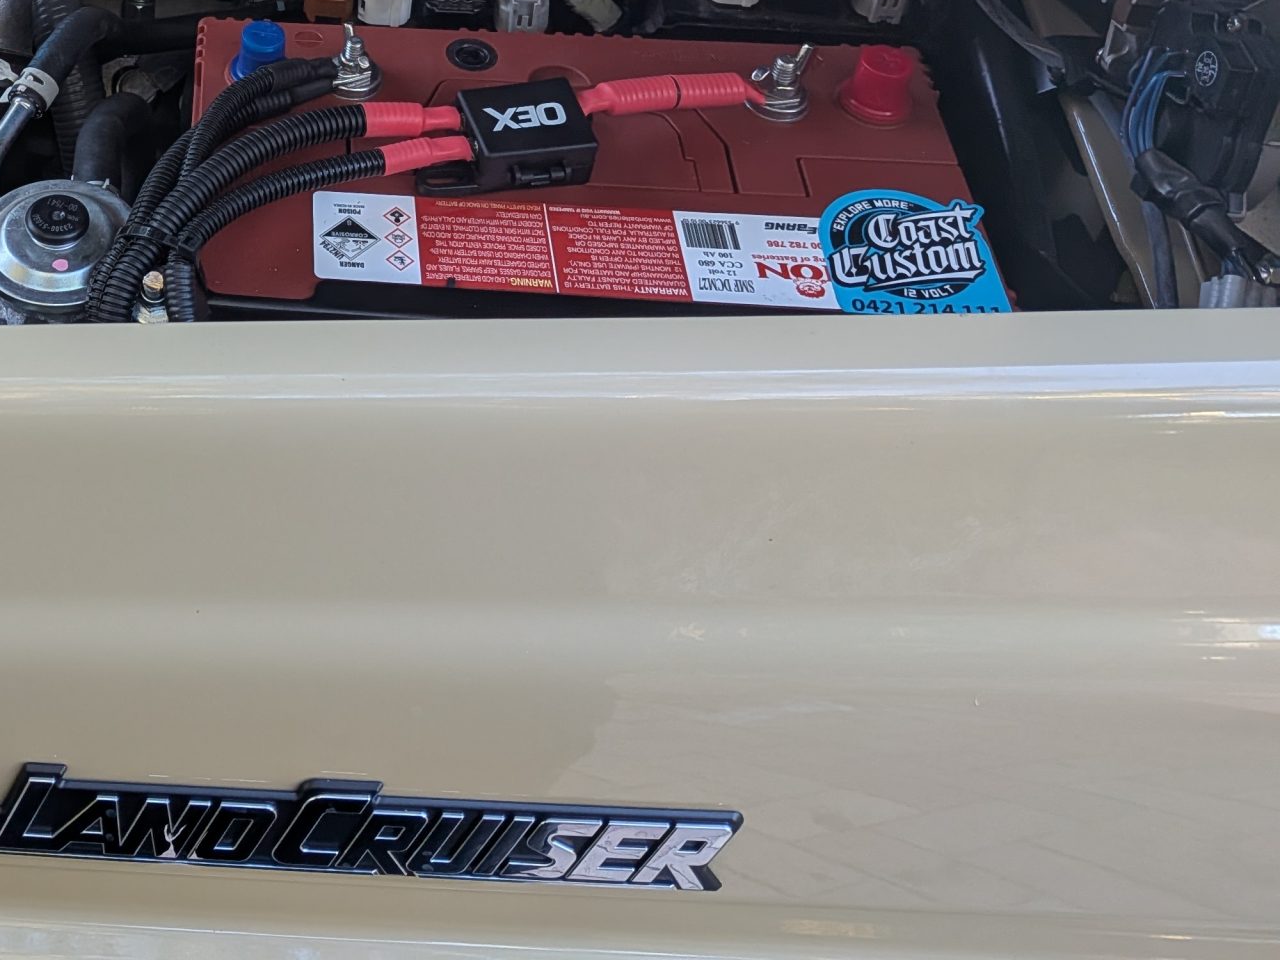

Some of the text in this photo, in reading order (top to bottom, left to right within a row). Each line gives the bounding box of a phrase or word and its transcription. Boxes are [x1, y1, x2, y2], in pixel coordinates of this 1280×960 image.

[482, 102, 567, 131] OEX
[551, 225, 593, 233] CONDITIONS
[623, 222, 661, 230] WARRANTY
[763, 221, 817, 234] EBANG
[867, 203, 975, 248] Coast
[619, 242, 665, 250] WARRANTIES
[788, 240, 807, 248] 782
[566, 246, 610, 254] CONDITIONS
[623, 256, 663, 264] WARRANTY
[751, 253, 797, 262] Batteries
[832, 240, 984, 284] Custom
[339, 260, 364, 268] DANGER
[697, 259, 743, 268] CCA 680
[630, 270, 684, 279] WORKMANSHIP
[753, 261, 829, 281] ION
[573, 282, 611, 290] BATTERY
[631, 278, 686, 287] GUARANTEED
[696, 277, 755, 293] SMF DCM27
[904, 285, 956, 298] 12 VOLT
[852, 299, 905, 313] 0421
[271, 793, 734, 892] CRUISER
